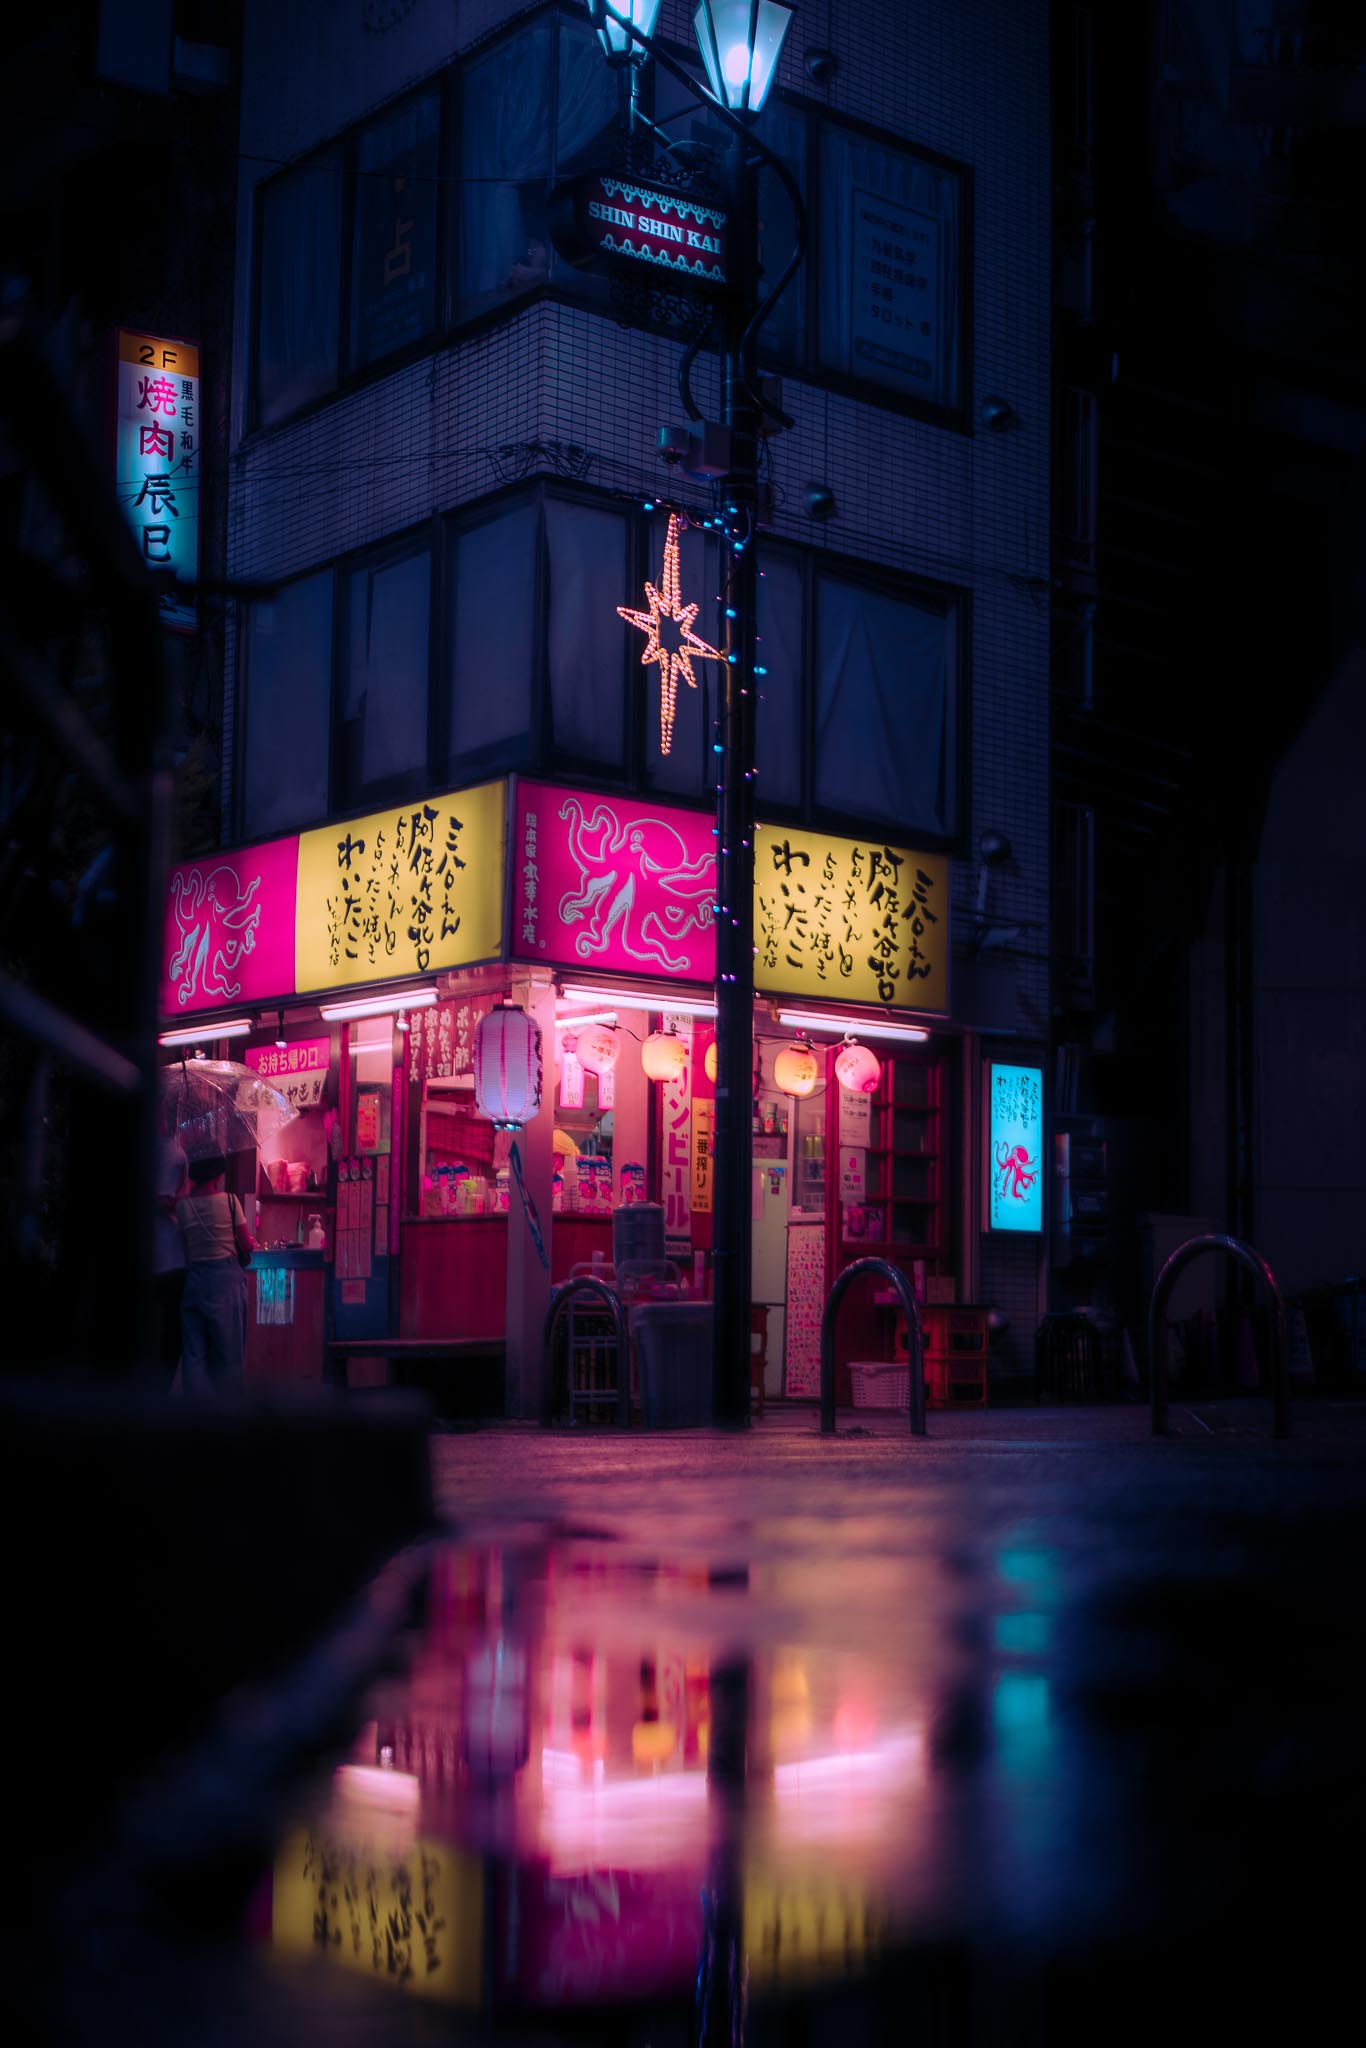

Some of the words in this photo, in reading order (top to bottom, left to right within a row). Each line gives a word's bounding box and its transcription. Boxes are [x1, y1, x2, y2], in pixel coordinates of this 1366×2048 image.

[589, 201, 636, 229] SHIN
[638, 215, 684, 243] SHIN
[687, 229, 721, 254] KAI
[138, 344, 178, 367] 2F
[136, 375, 179, 463] 焼肉
[180, 379, 194, 477] 黒毛和牛
[336, 832, 366, 959] わいたこ
[770, 839, 811, 970] わいたこ
[257, 1046, 319, 1075] お持ち帰り口
[455, 1006, 470, 1070] ポン酢
[696, 1130, 710, 1190] 一番搾り
